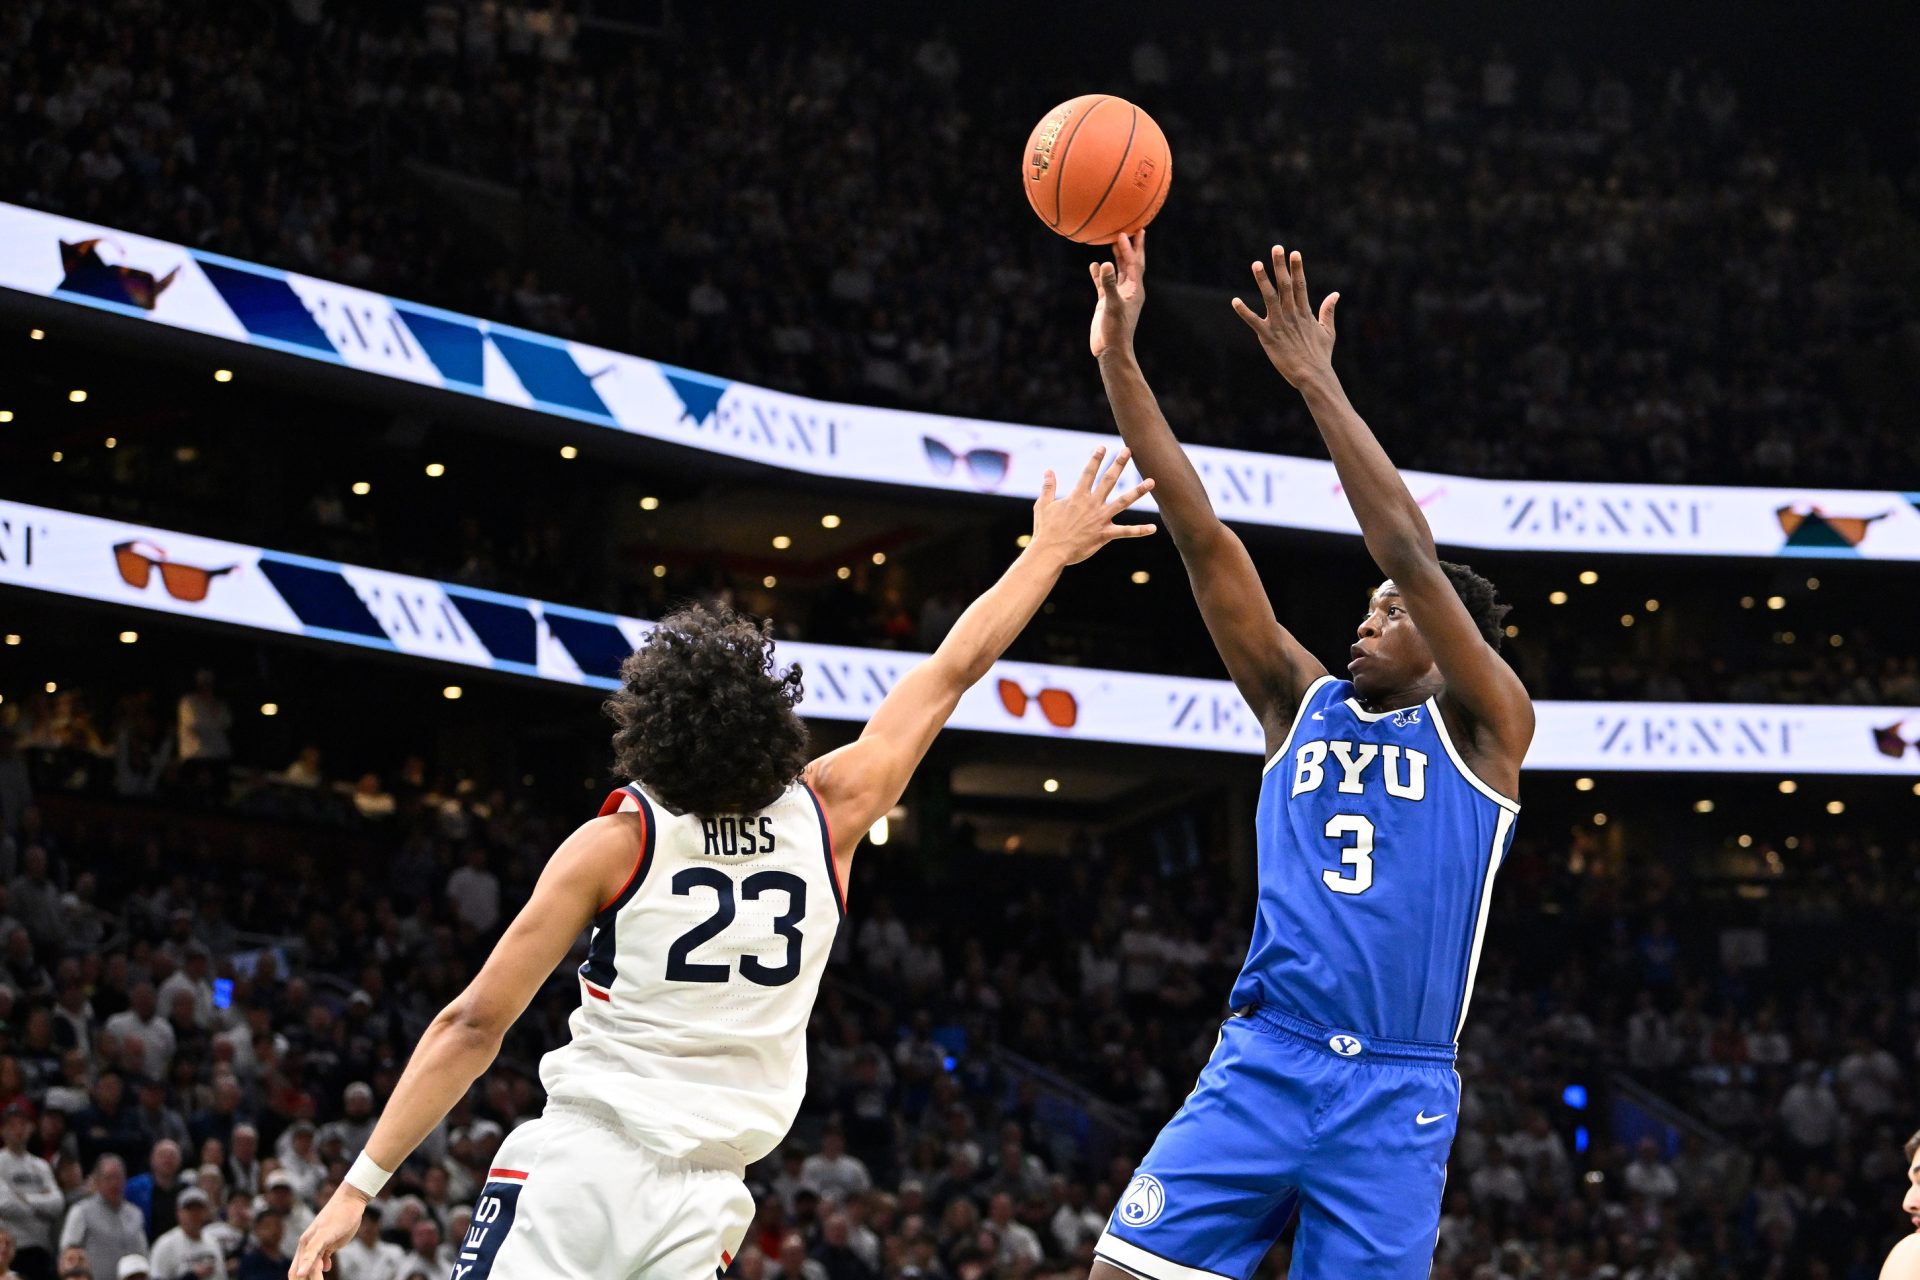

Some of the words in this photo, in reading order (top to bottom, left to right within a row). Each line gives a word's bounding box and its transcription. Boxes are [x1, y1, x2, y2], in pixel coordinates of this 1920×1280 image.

[680, 399, 837, 456] ENNI
[1503, 496, 1700, 536] ZENNI
[1596, 717, 1791, 756] ZENNI
[1291, 740, 1428, 802] BYU
[701, 816, 776, 856] ROSS
[1321, 813, 1376, 895] 3
[665, 866, 808, 987] 23
